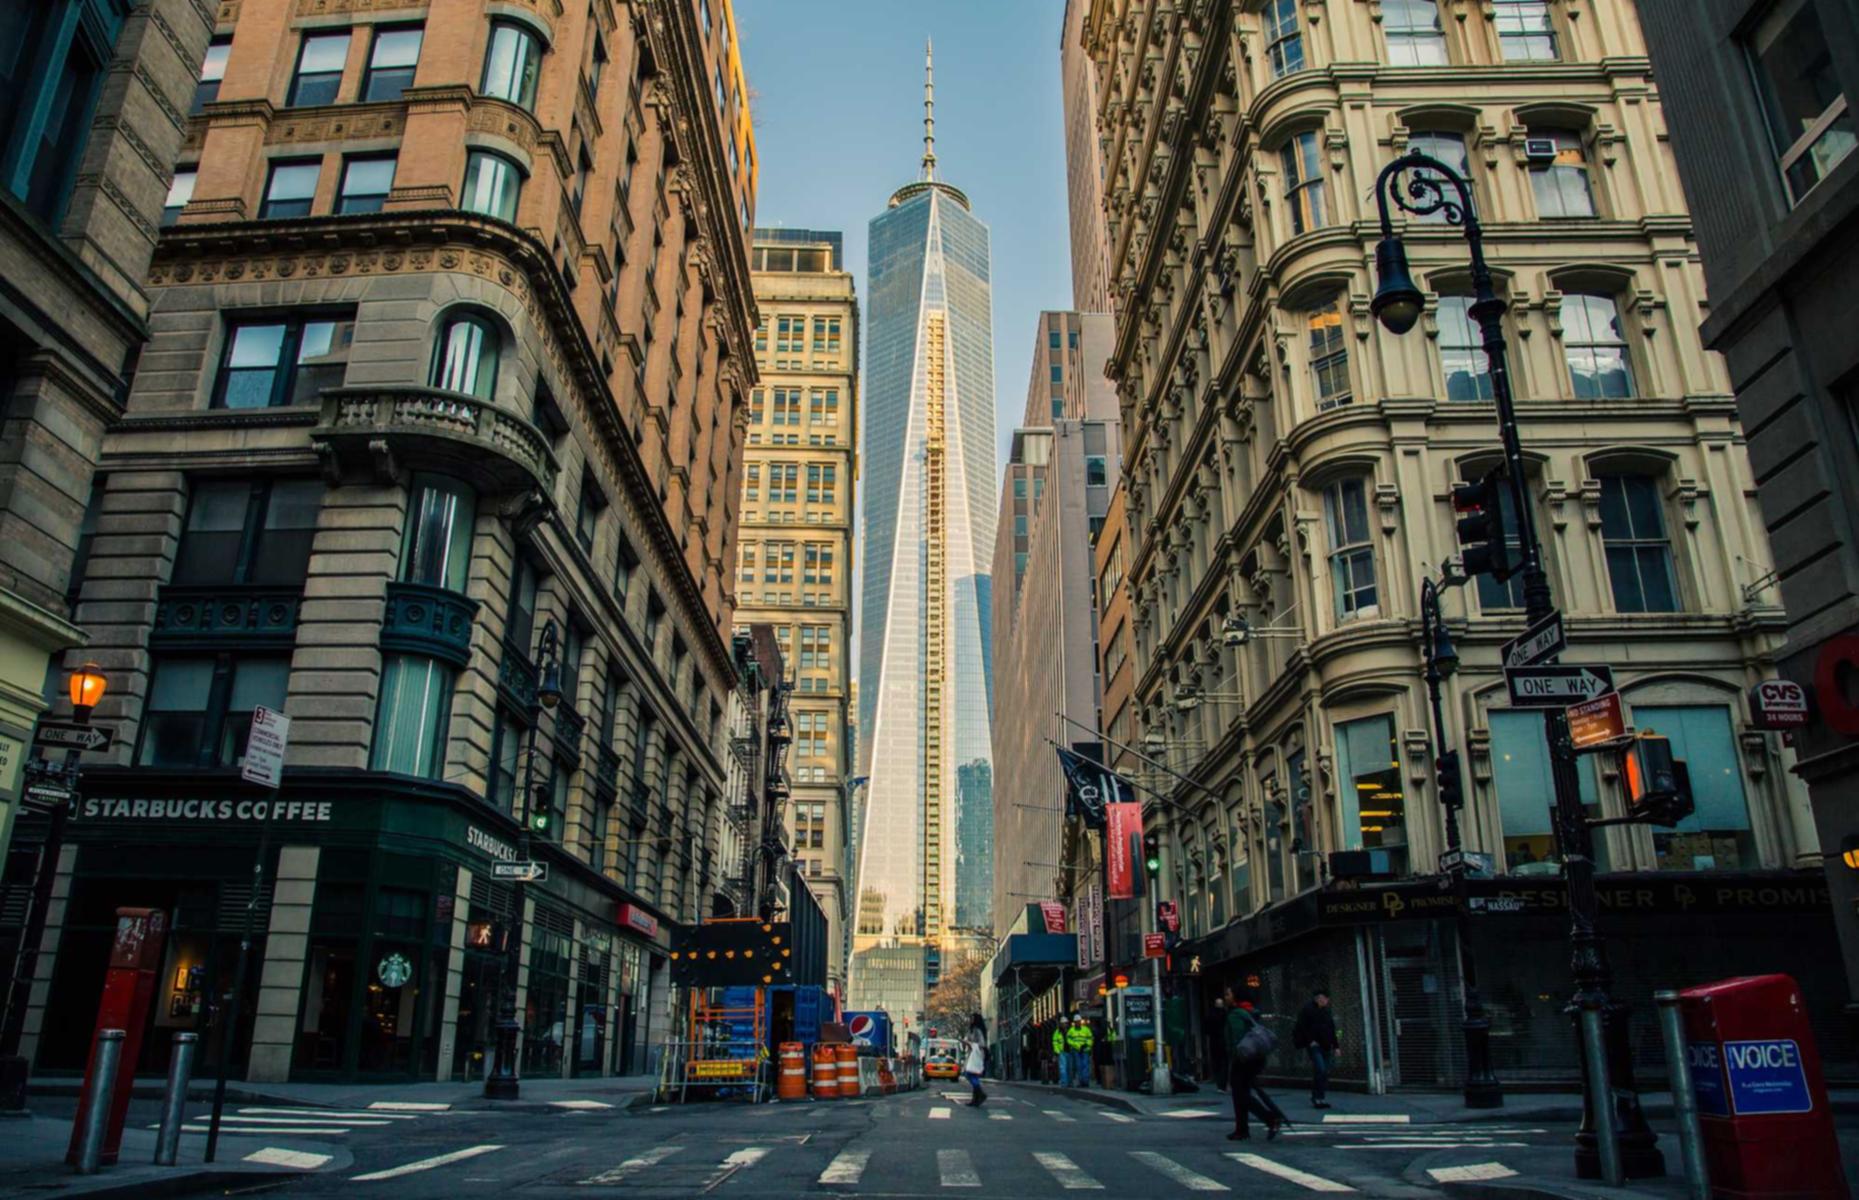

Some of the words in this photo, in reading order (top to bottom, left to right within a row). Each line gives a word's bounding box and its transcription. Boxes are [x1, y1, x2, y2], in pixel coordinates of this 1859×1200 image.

[1511, 646, 1529, 666] ONE
[1535, 627, 1555, 651] WAY
[1523, 679, 1554, 694] ONE
[1566, 679, 1597, 694] WAY
[1761, 685, 1801, 701] CVS
[1580, 698, 1612, 715] STANDING
[1778, 713, 1804, 722] HOURS
[44, 729, 68, 740] ONE
[76, 732, 101, 744] WAY
[84, 797, 233, 820] STARBUCKS
[236, 800, 333, 821] COFFEE
[467, 825, 513, 862] STARBUCKS
[1326, 900, 1377, 914] DESIGNER
[1487, 900, 1520, 912] NASSAU
[1499, 889, 1655, 908] DESINER
[1687, 1044, 1719, 1069] OICE
[1731, 1043, 1797, 1070] VOICE
